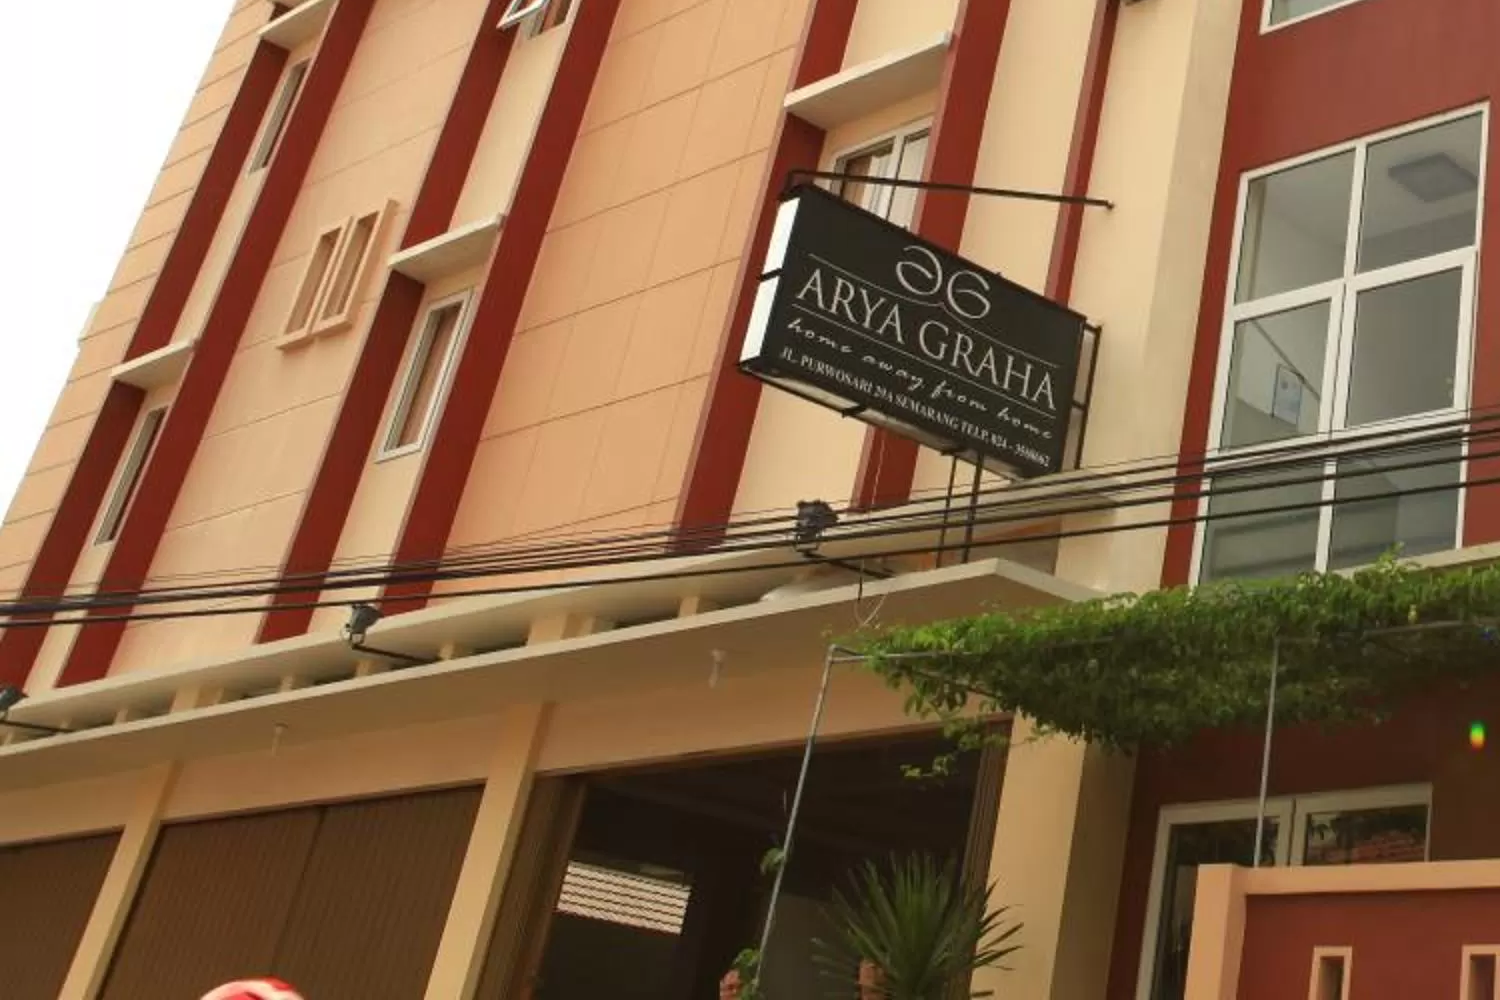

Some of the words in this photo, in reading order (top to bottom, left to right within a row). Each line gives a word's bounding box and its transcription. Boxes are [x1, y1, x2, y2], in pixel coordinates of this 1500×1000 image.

[788, 318, 852, 353] home
[862, 354, 925, 391] away
[930, 380, 988, 411] from
[997, 408, 1053, 440] home
[795, 268, 904, 345] ARYA
[917, 319, 1057, 411] GRAHA
[800, 355, 873, 393] PURWOSARI
[895, 390, 960, 430] SEMARANG
